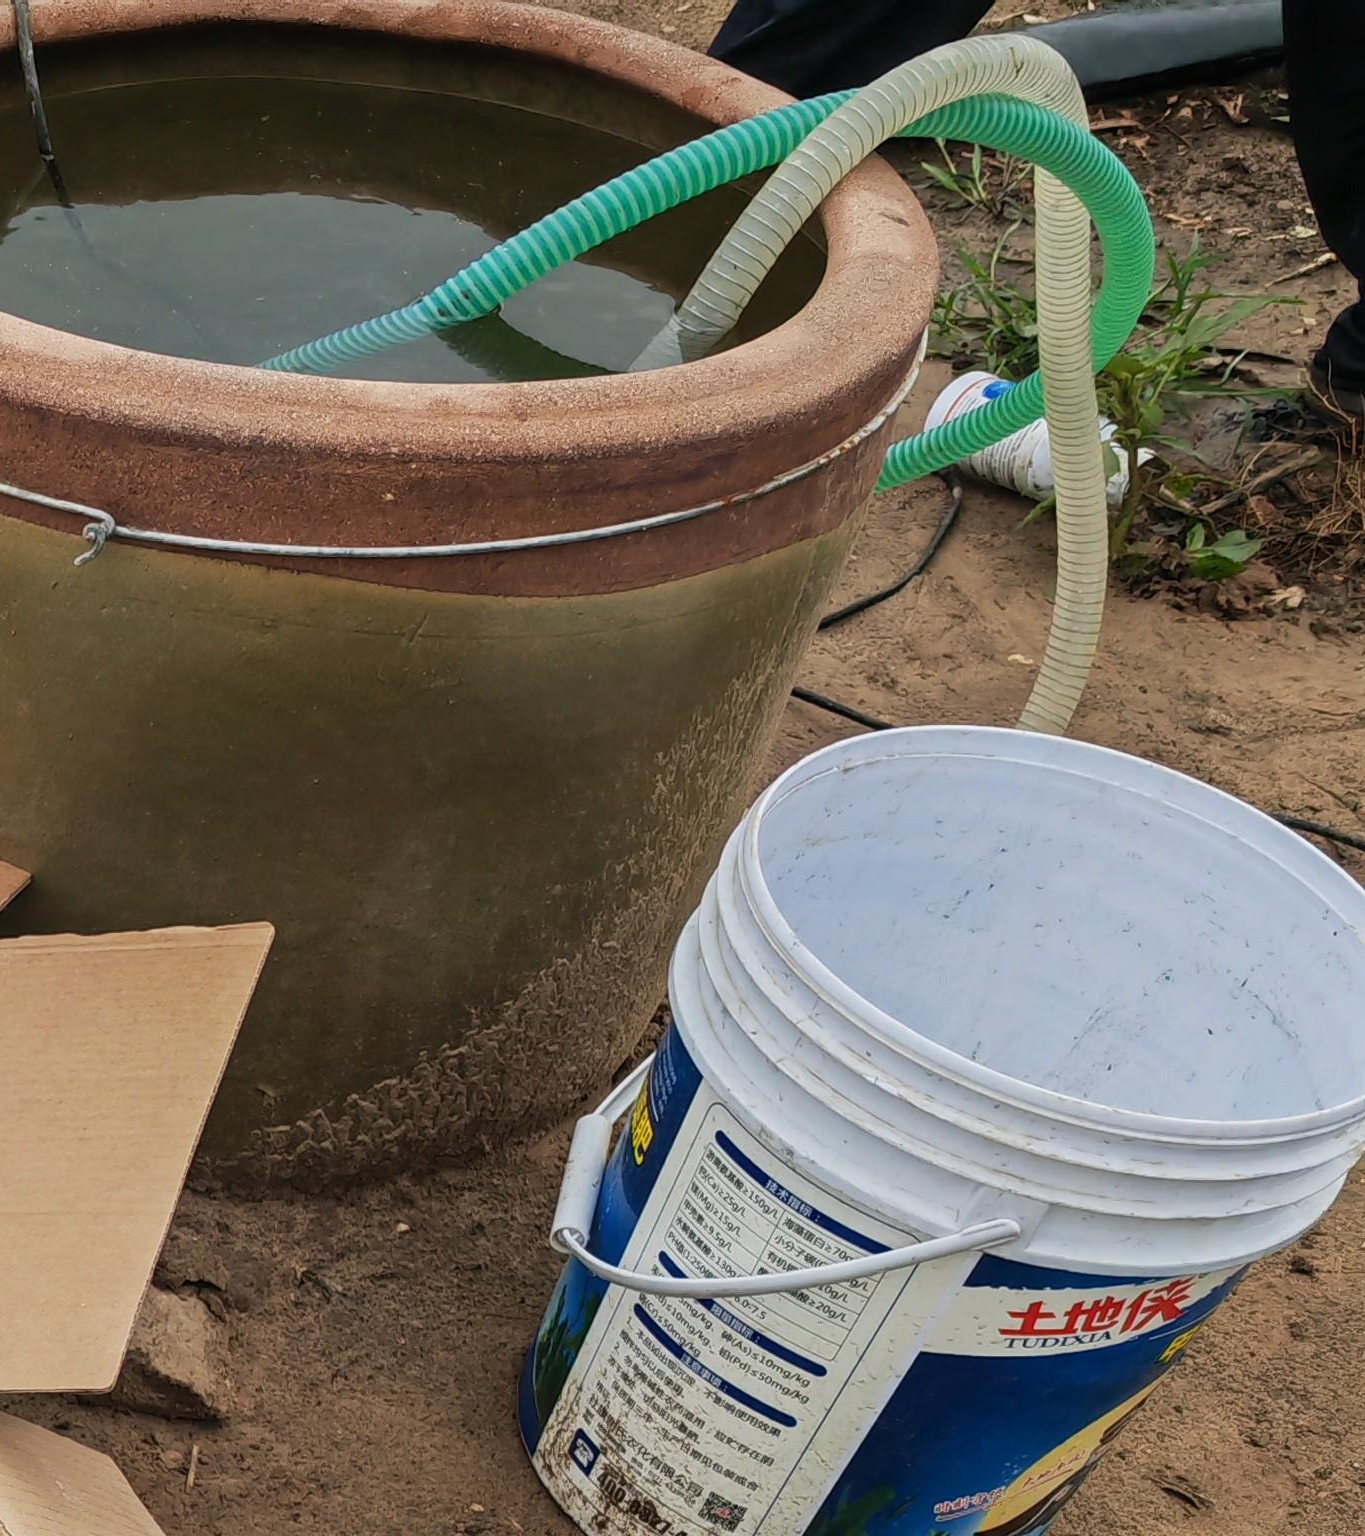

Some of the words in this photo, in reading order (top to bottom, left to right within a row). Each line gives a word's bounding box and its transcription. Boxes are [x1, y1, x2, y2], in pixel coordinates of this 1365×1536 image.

[998, 1275, 1198, 1337] 土地侠
[1004, 1330, 1112, 1349] TUDIXIA
